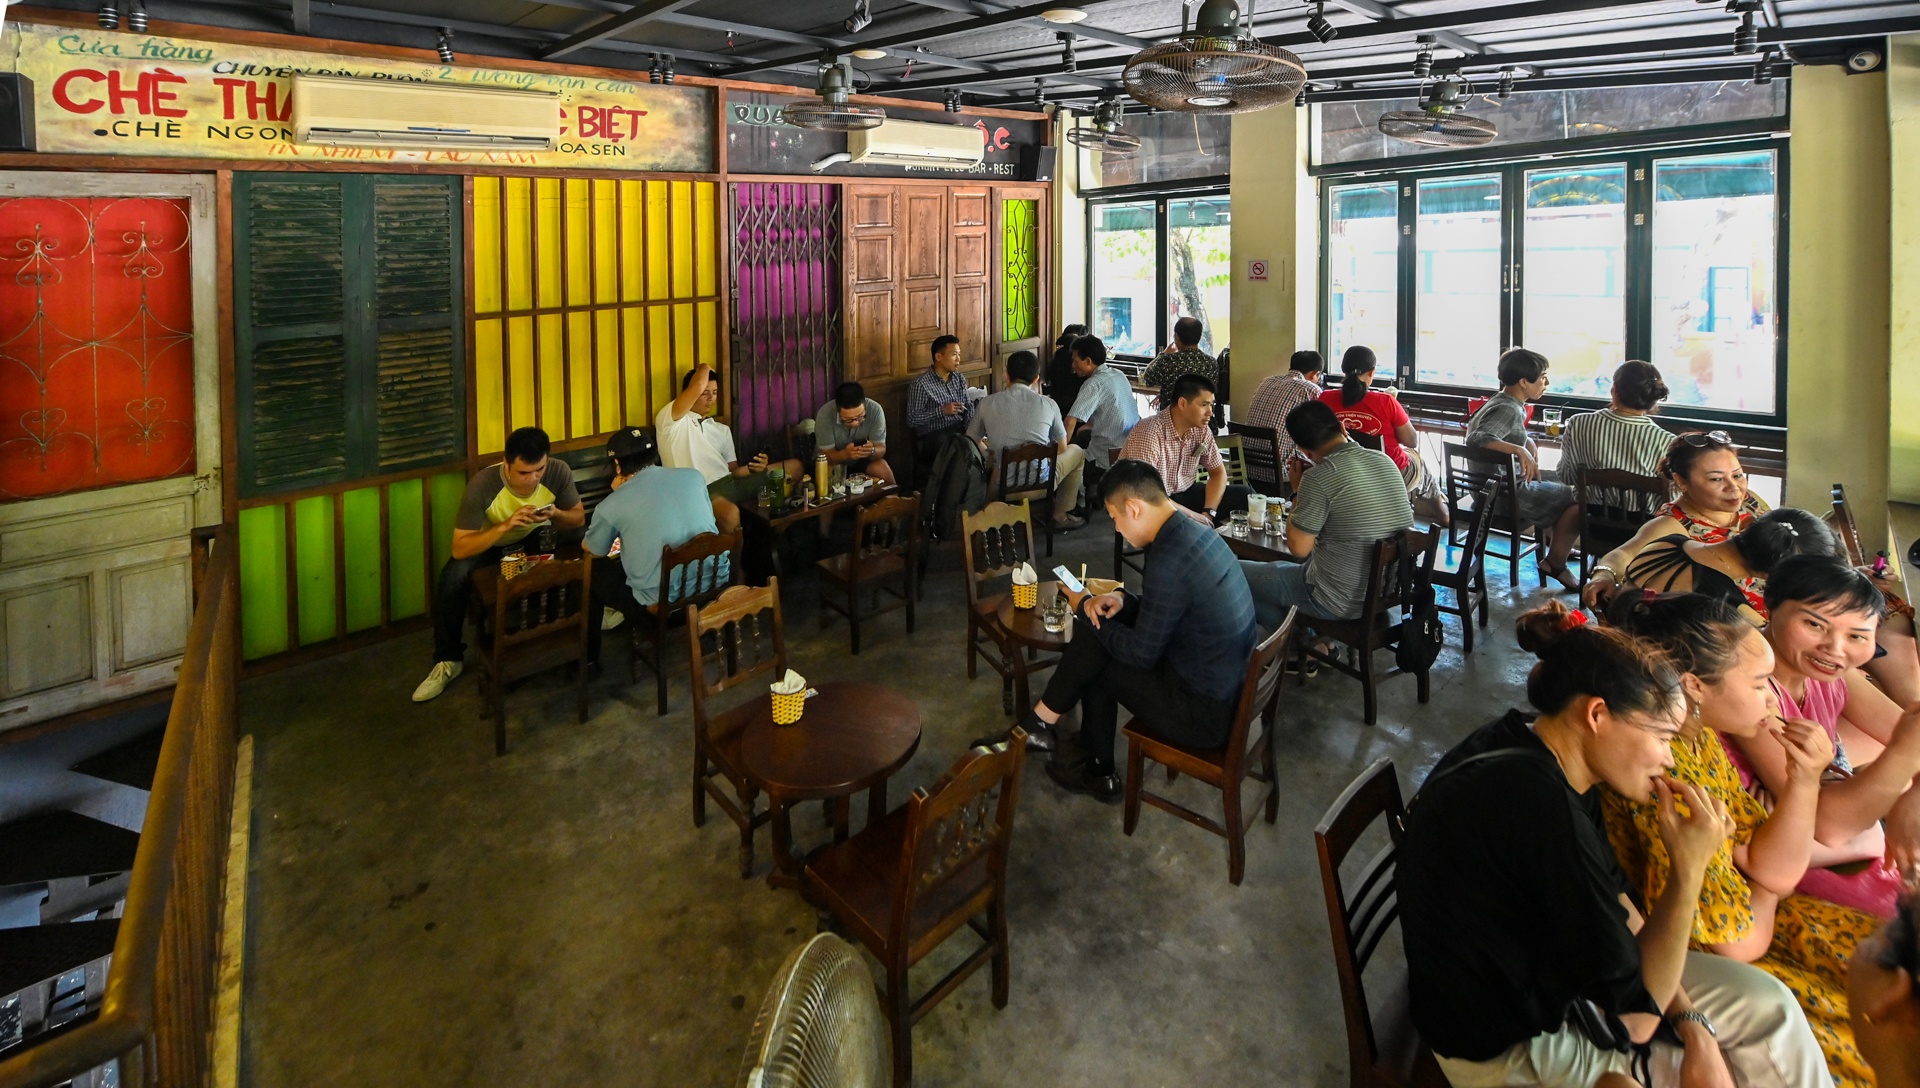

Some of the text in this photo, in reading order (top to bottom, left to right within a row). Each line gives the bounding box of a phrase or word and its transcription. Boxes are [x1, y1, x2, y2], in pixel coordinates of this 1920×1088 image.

[137, 37, 213, 63] hàng
[52, 67, 188, 118] CHÈ
[578, 105, 648, 143] BIỆT
[112, 119, 181, 138] CHÈ
[555, 143, 626, 156] OASEN
[968, 163, 986, 174] BAR
[994, 164, 1015, 176] REST
